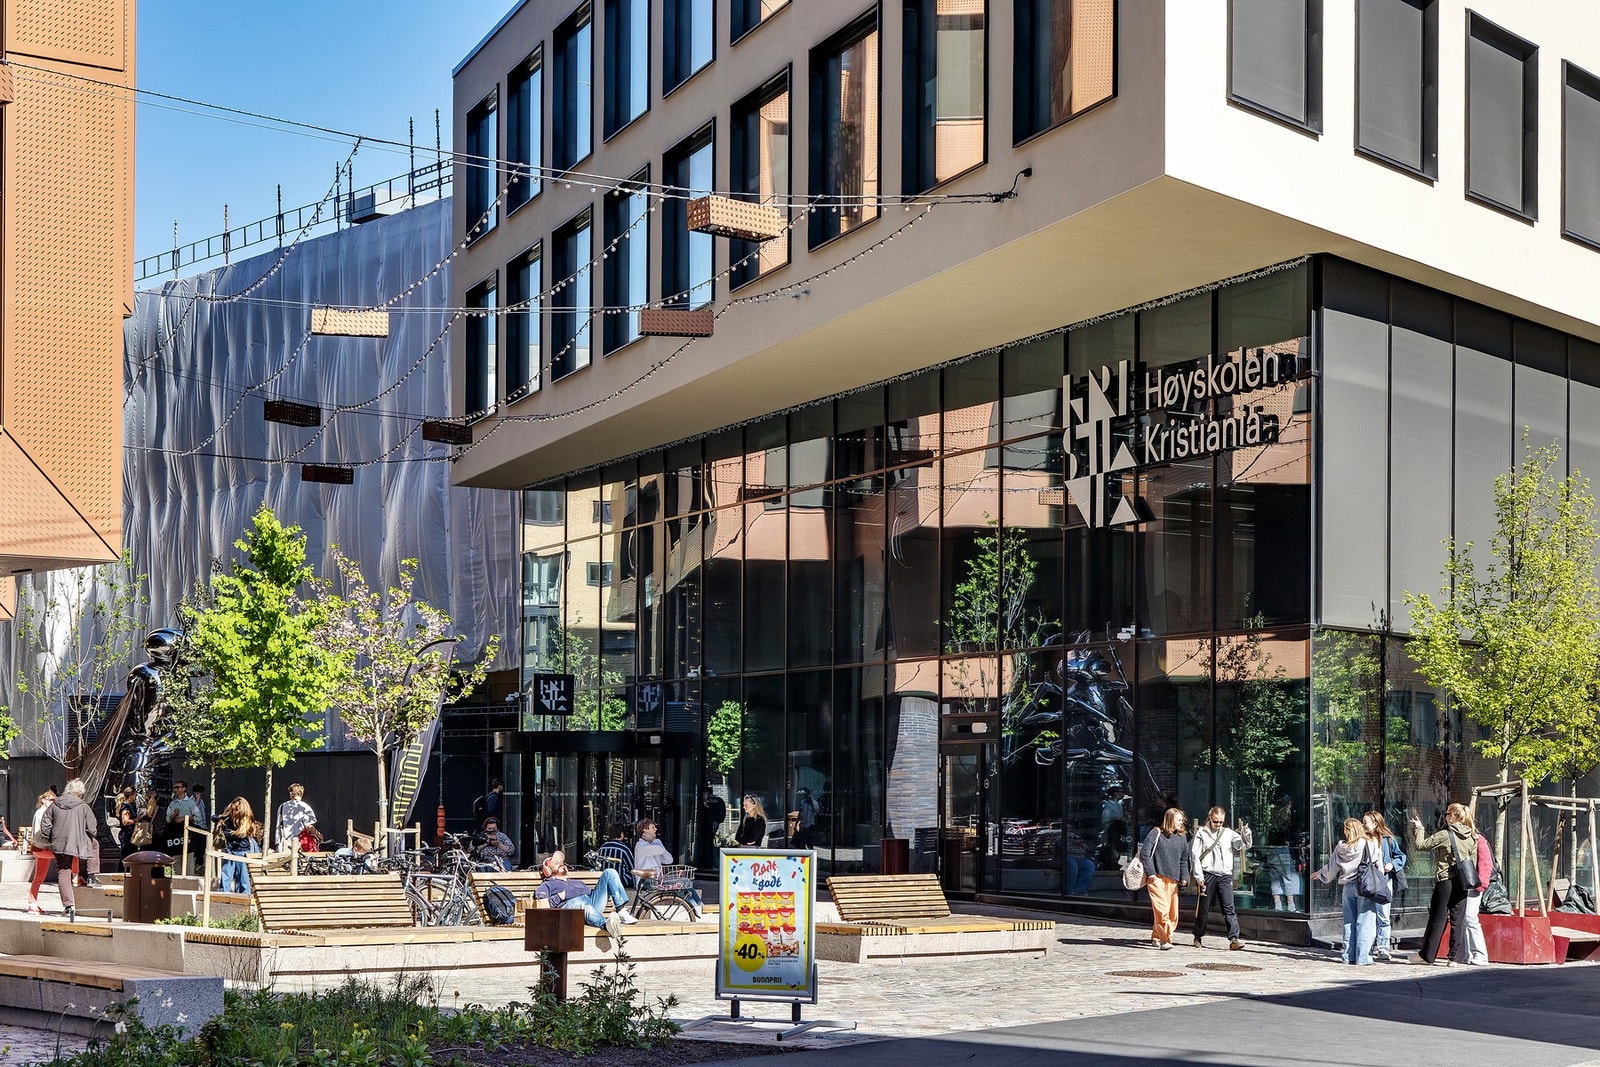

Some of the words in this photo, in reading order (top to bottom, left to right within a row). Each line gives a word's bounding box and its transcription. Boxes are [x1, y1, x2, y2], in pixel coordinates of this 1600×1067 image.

[1145, 346, 1279, 411] Høyskolen
[1145, 407, 1263, 464] Kristiania
[758, 875, 782, 891] godt
[752, 976, 783, 984] BUNNPRIS
